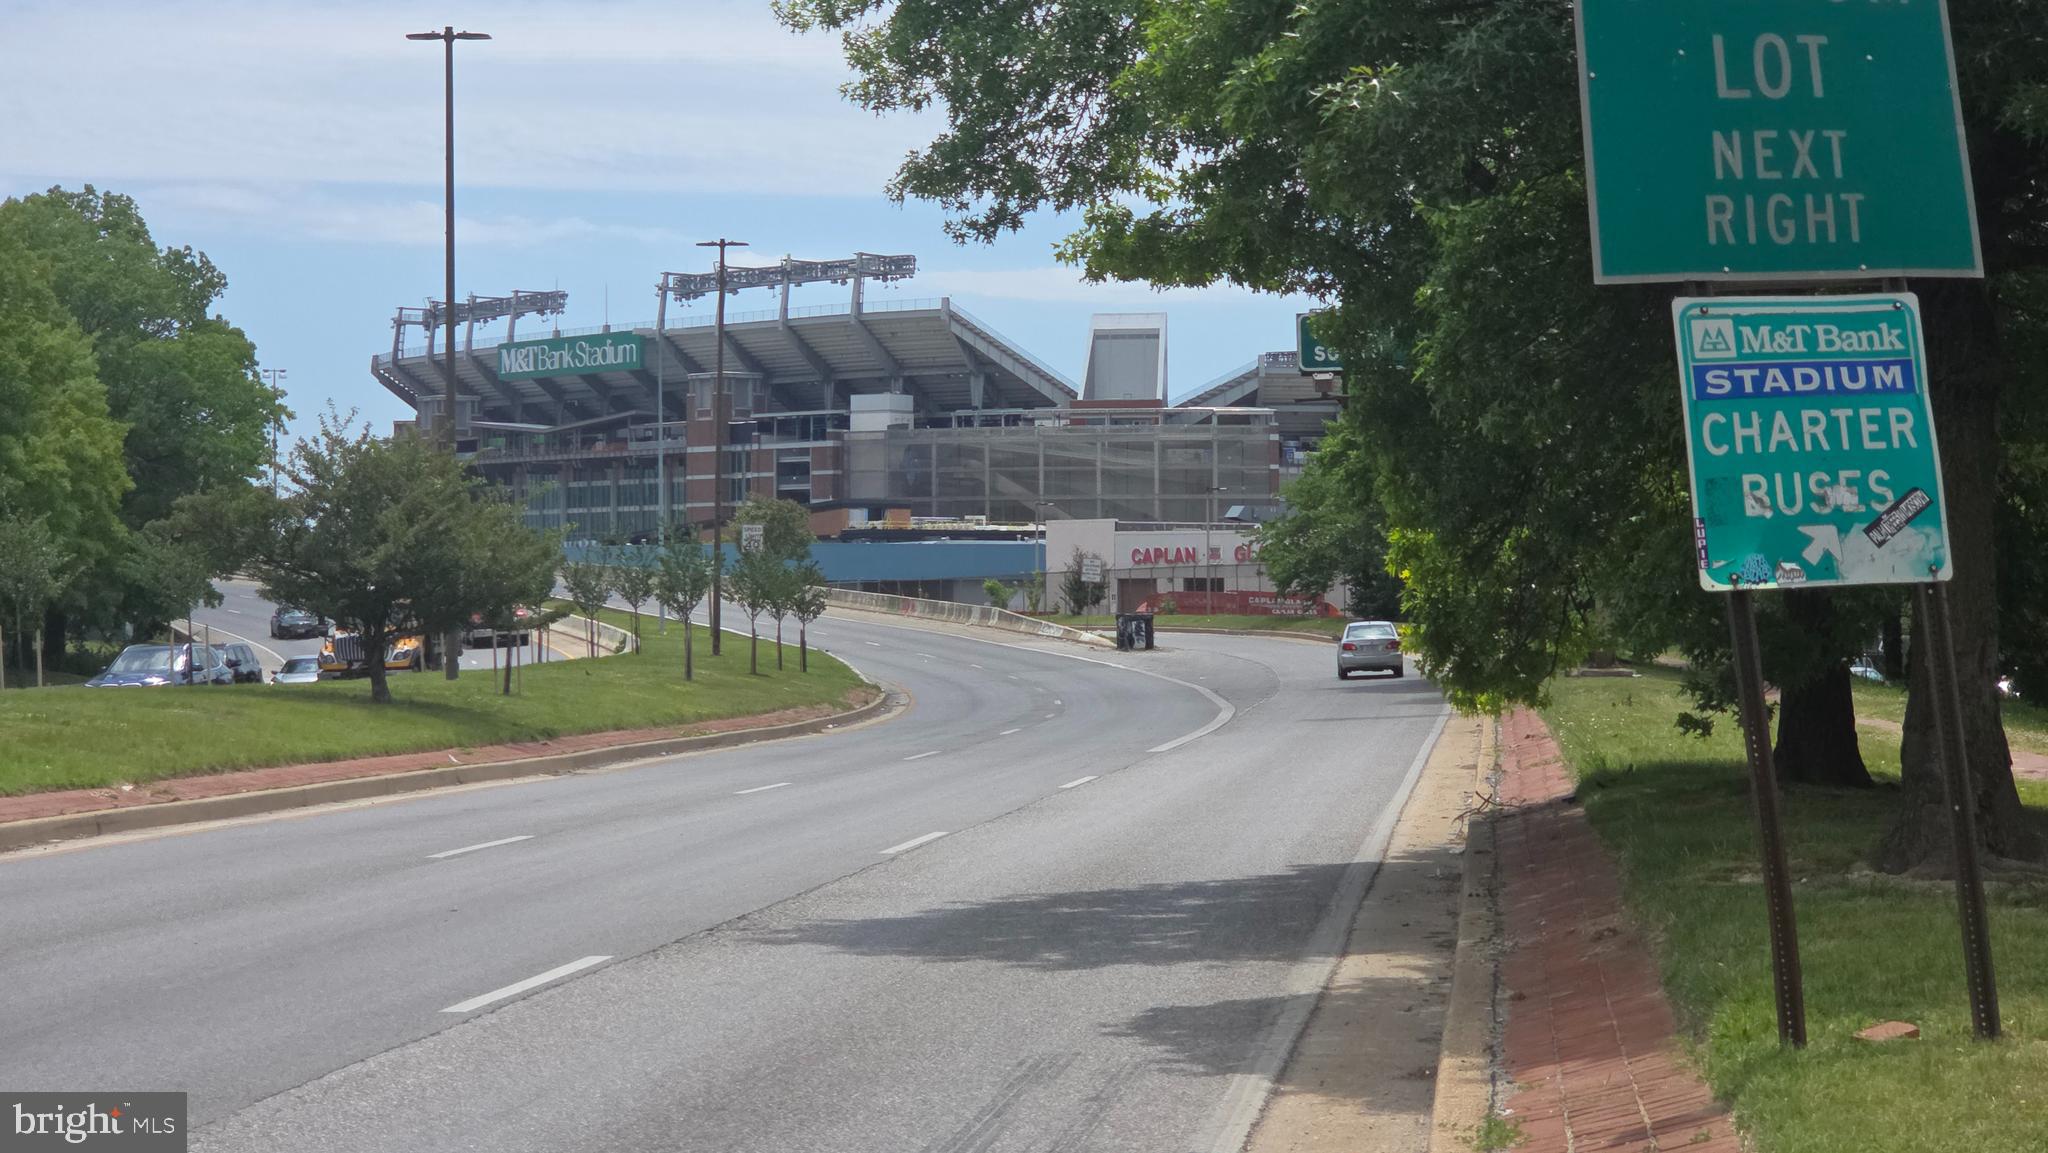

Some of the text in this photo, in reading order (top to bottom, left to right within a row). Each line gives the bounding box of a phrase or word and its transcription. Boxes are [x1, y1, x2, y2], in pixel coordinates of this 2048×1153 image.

[1712, 32, 1829, 99] LOT
[1712, 130, 1847, 180] NEXT
[1706, 193, 1865, 245] RIGHT
[500, 339, 637, 374] M&T Bank Stadium
[1739, 322, 1905, 354] M&T Bank
[1705, 364, 1904, 395] STADIUM
[1702, 407, 1918, 456] CHARTER
[1742, 469, 1895, 519] BUSES
[1131, 546, 1197, 565] CAPLAN
[1695, 518, 1709, 569] LUPIE
